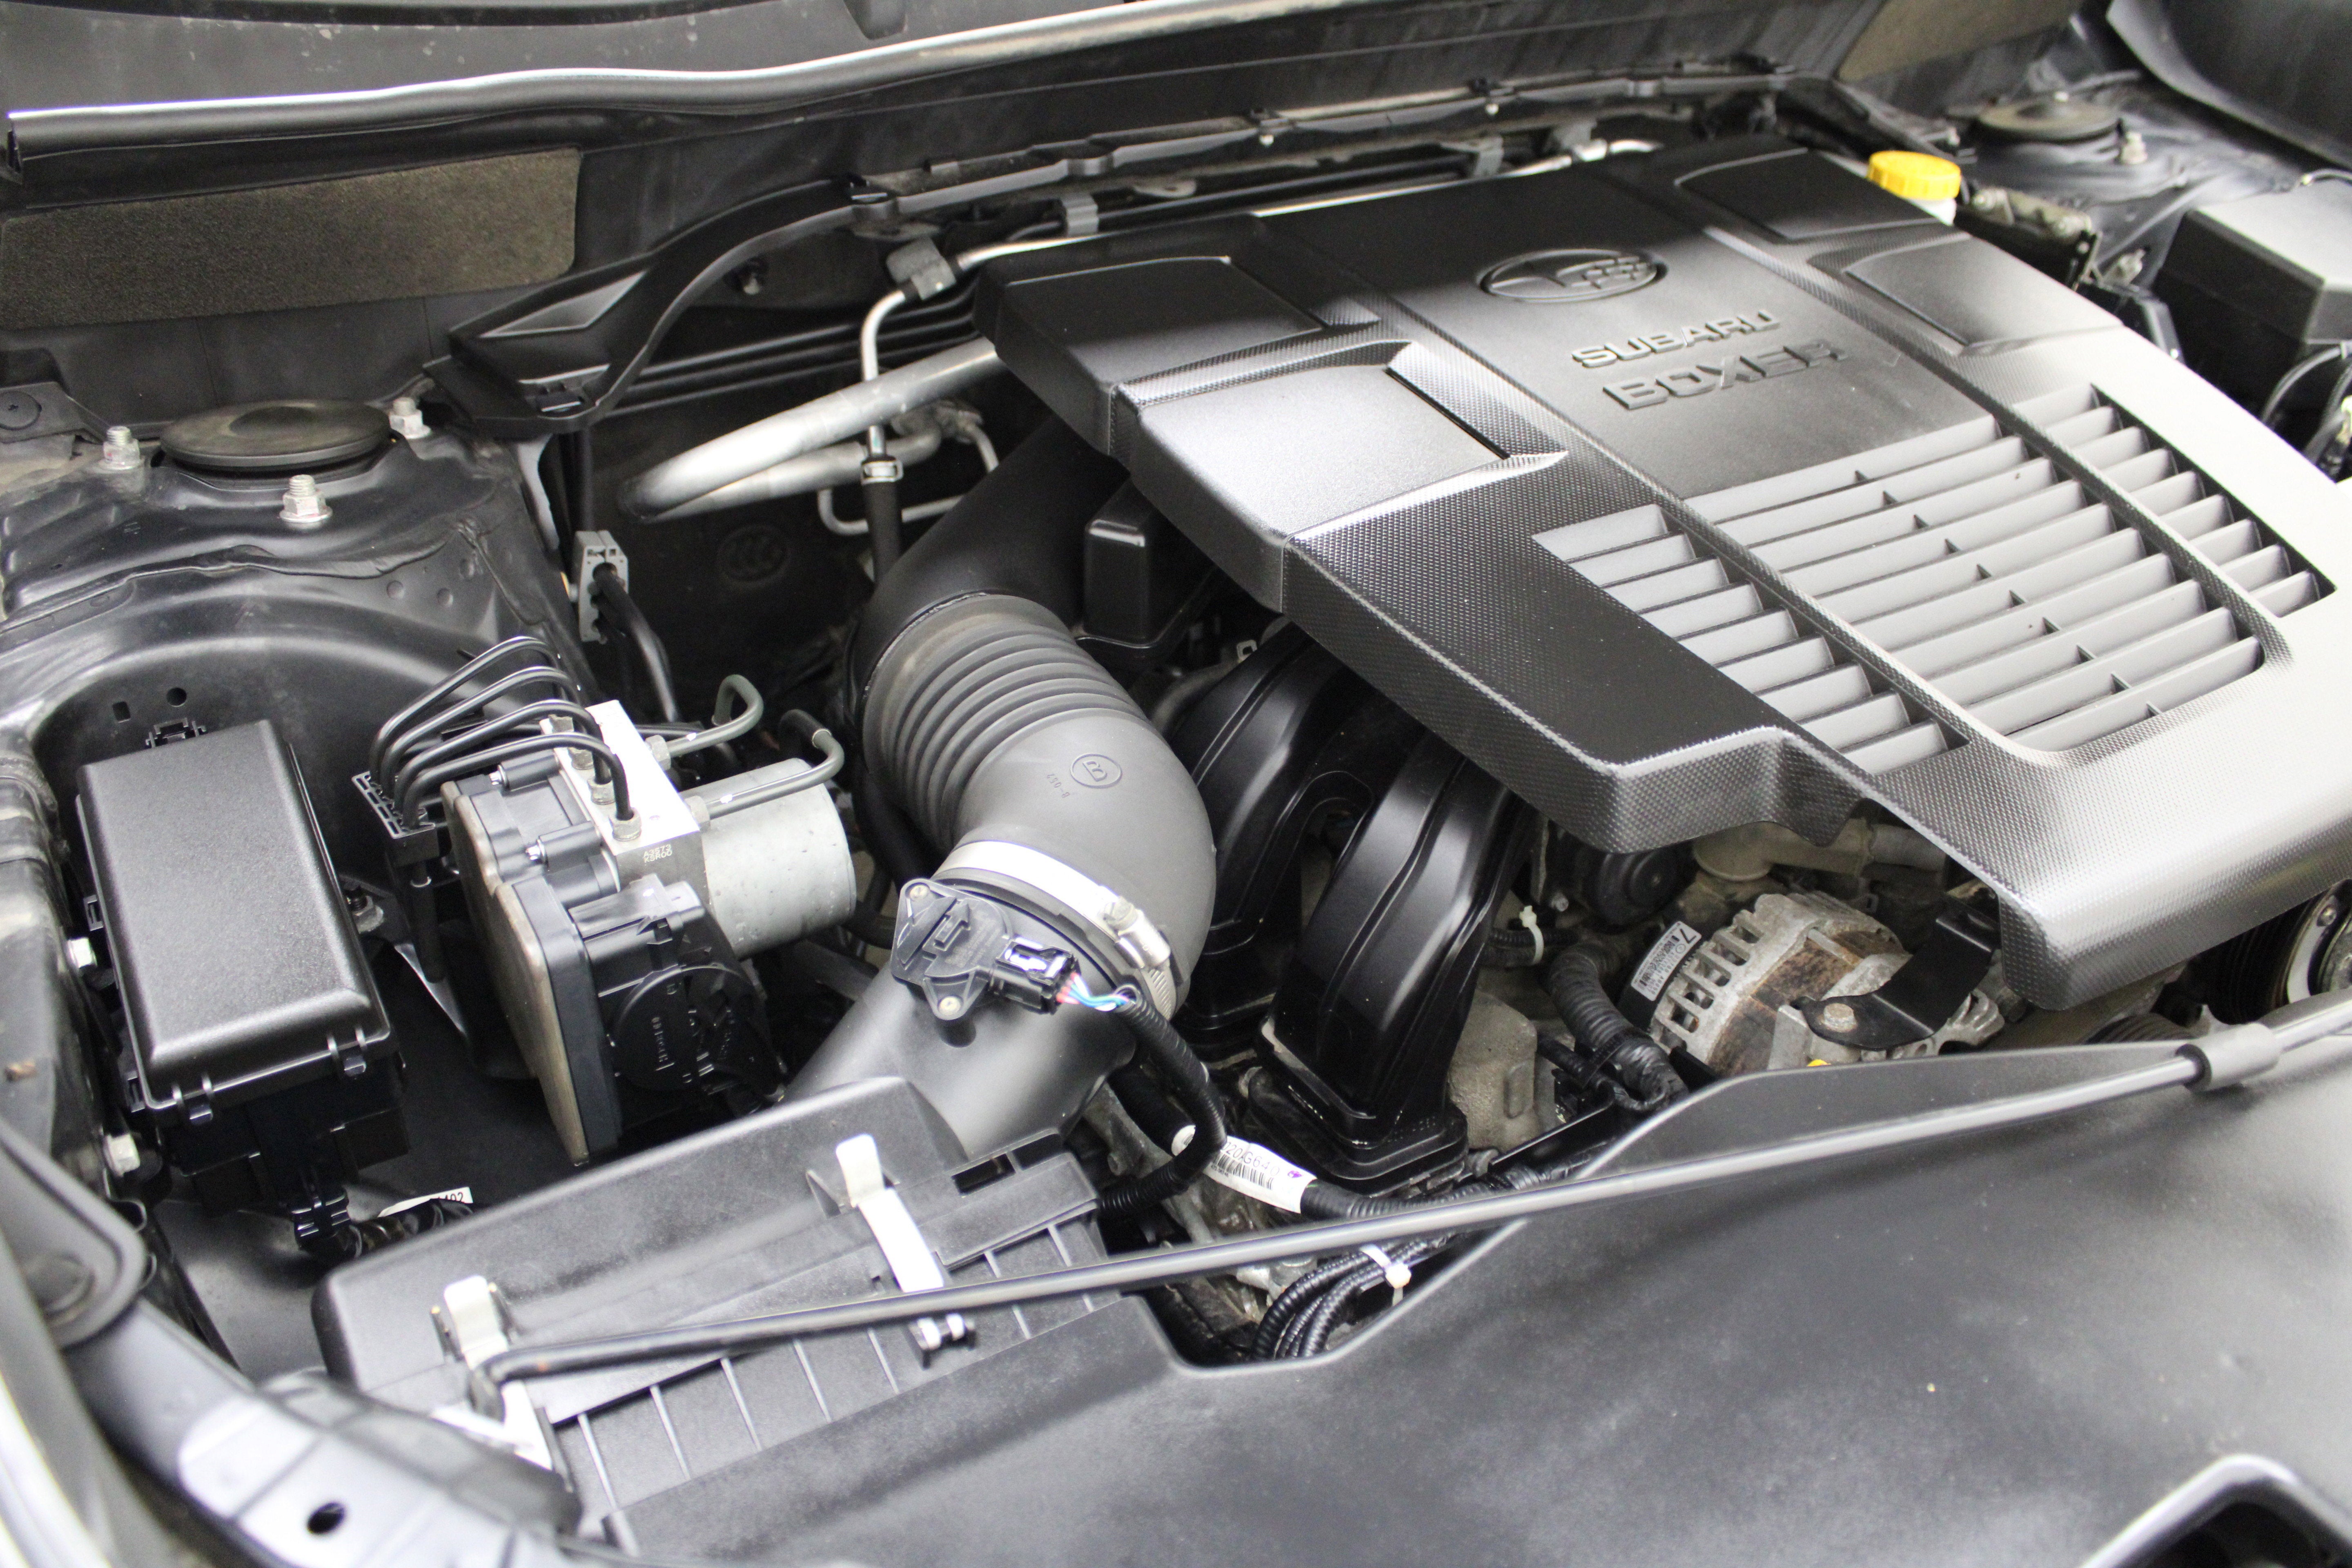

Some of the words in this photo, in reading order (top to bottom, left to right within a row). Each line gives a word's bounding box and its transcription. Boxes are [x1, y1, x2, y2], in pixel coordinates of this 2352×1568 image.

[1571, 309, 1780, 368] SUBARU
[1602, 338, 1848, 411] BOXER
[1082, 760, 1107, 782] B
[644, 844, 671, 858] A3573
